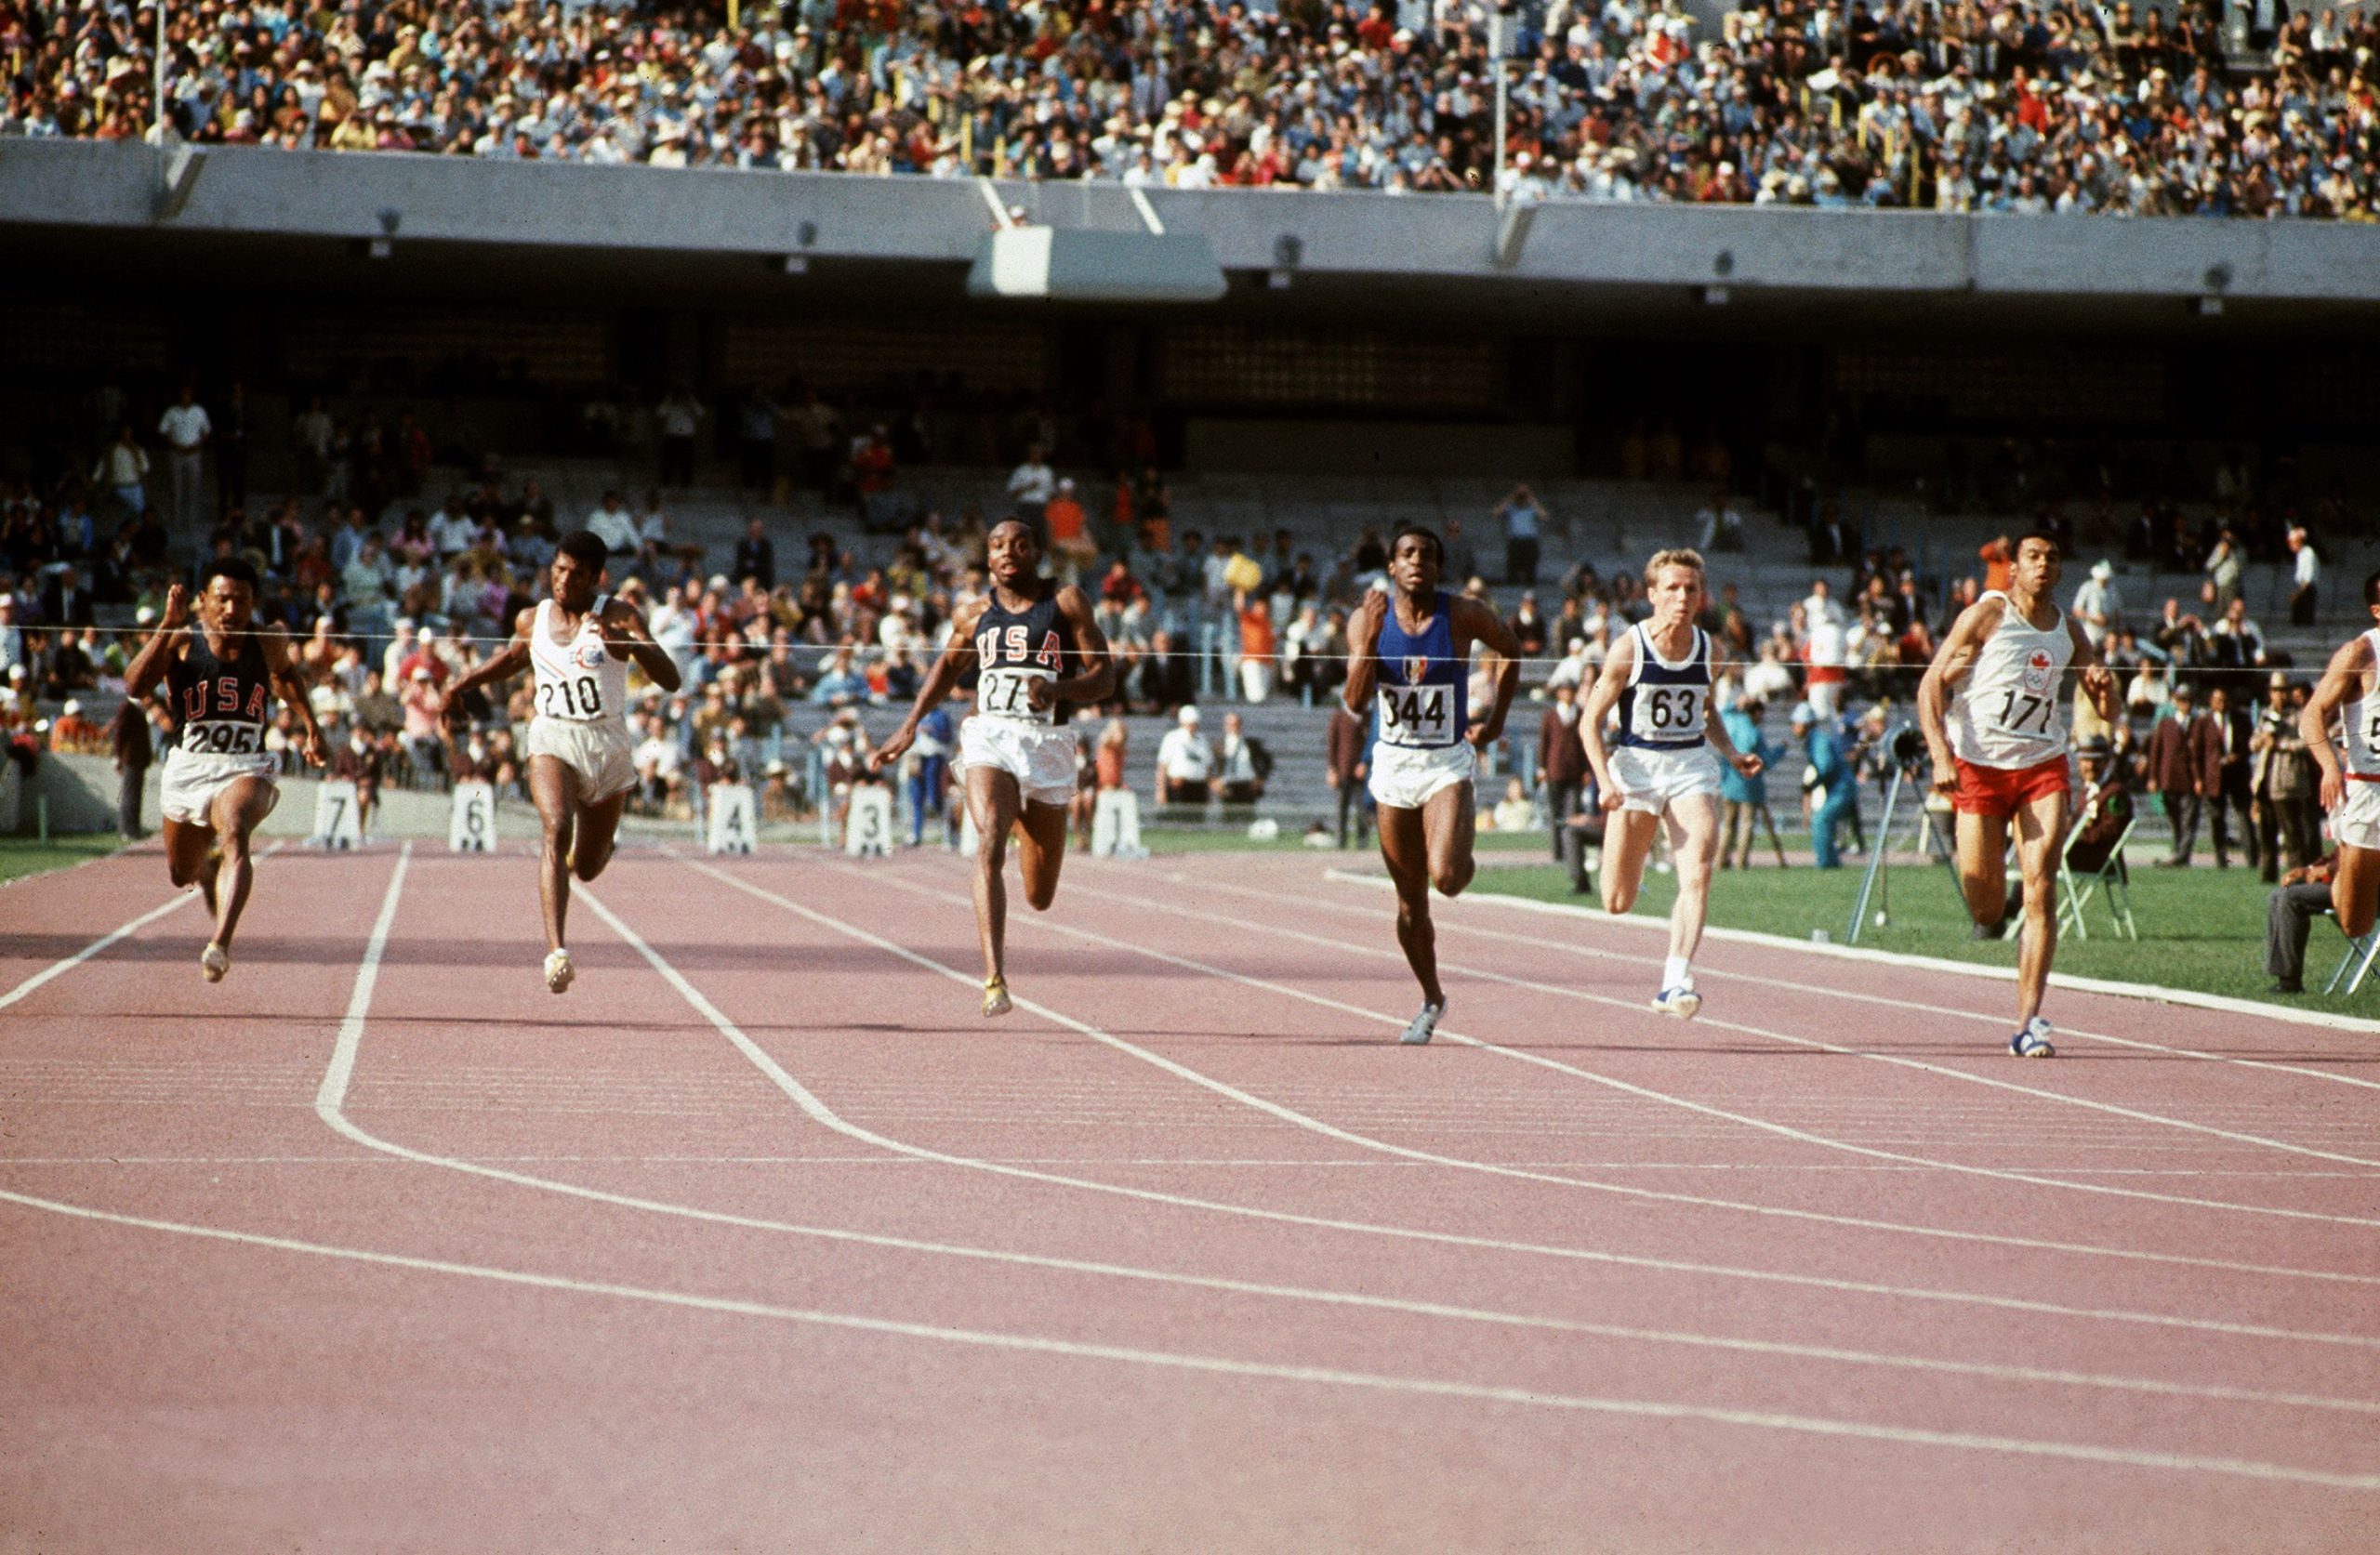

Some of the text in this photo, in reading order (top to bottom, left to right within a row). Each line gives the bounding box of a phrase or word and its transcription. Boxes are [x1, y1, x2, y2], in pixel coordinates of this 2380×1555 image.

[976, 626, 1063, 673] USA
[183, 677, 265, 724] USA
[541, 676, 601, 717] 210
[985, 673, 1041, 714] 27
[1383, 689, 1446, 731] 344
[1651, 689, 1696, 729] 63
[2000, 691, 2053, 733] 171
[189, 724, 256, 754] 295
[329, 797, 346, 838] 7
[467, 799, 483, 835] 6
[727, 804, 742, 832] 4
[863, 804, 879, 838] 3
[1112, 807, 1121, 838] 1
